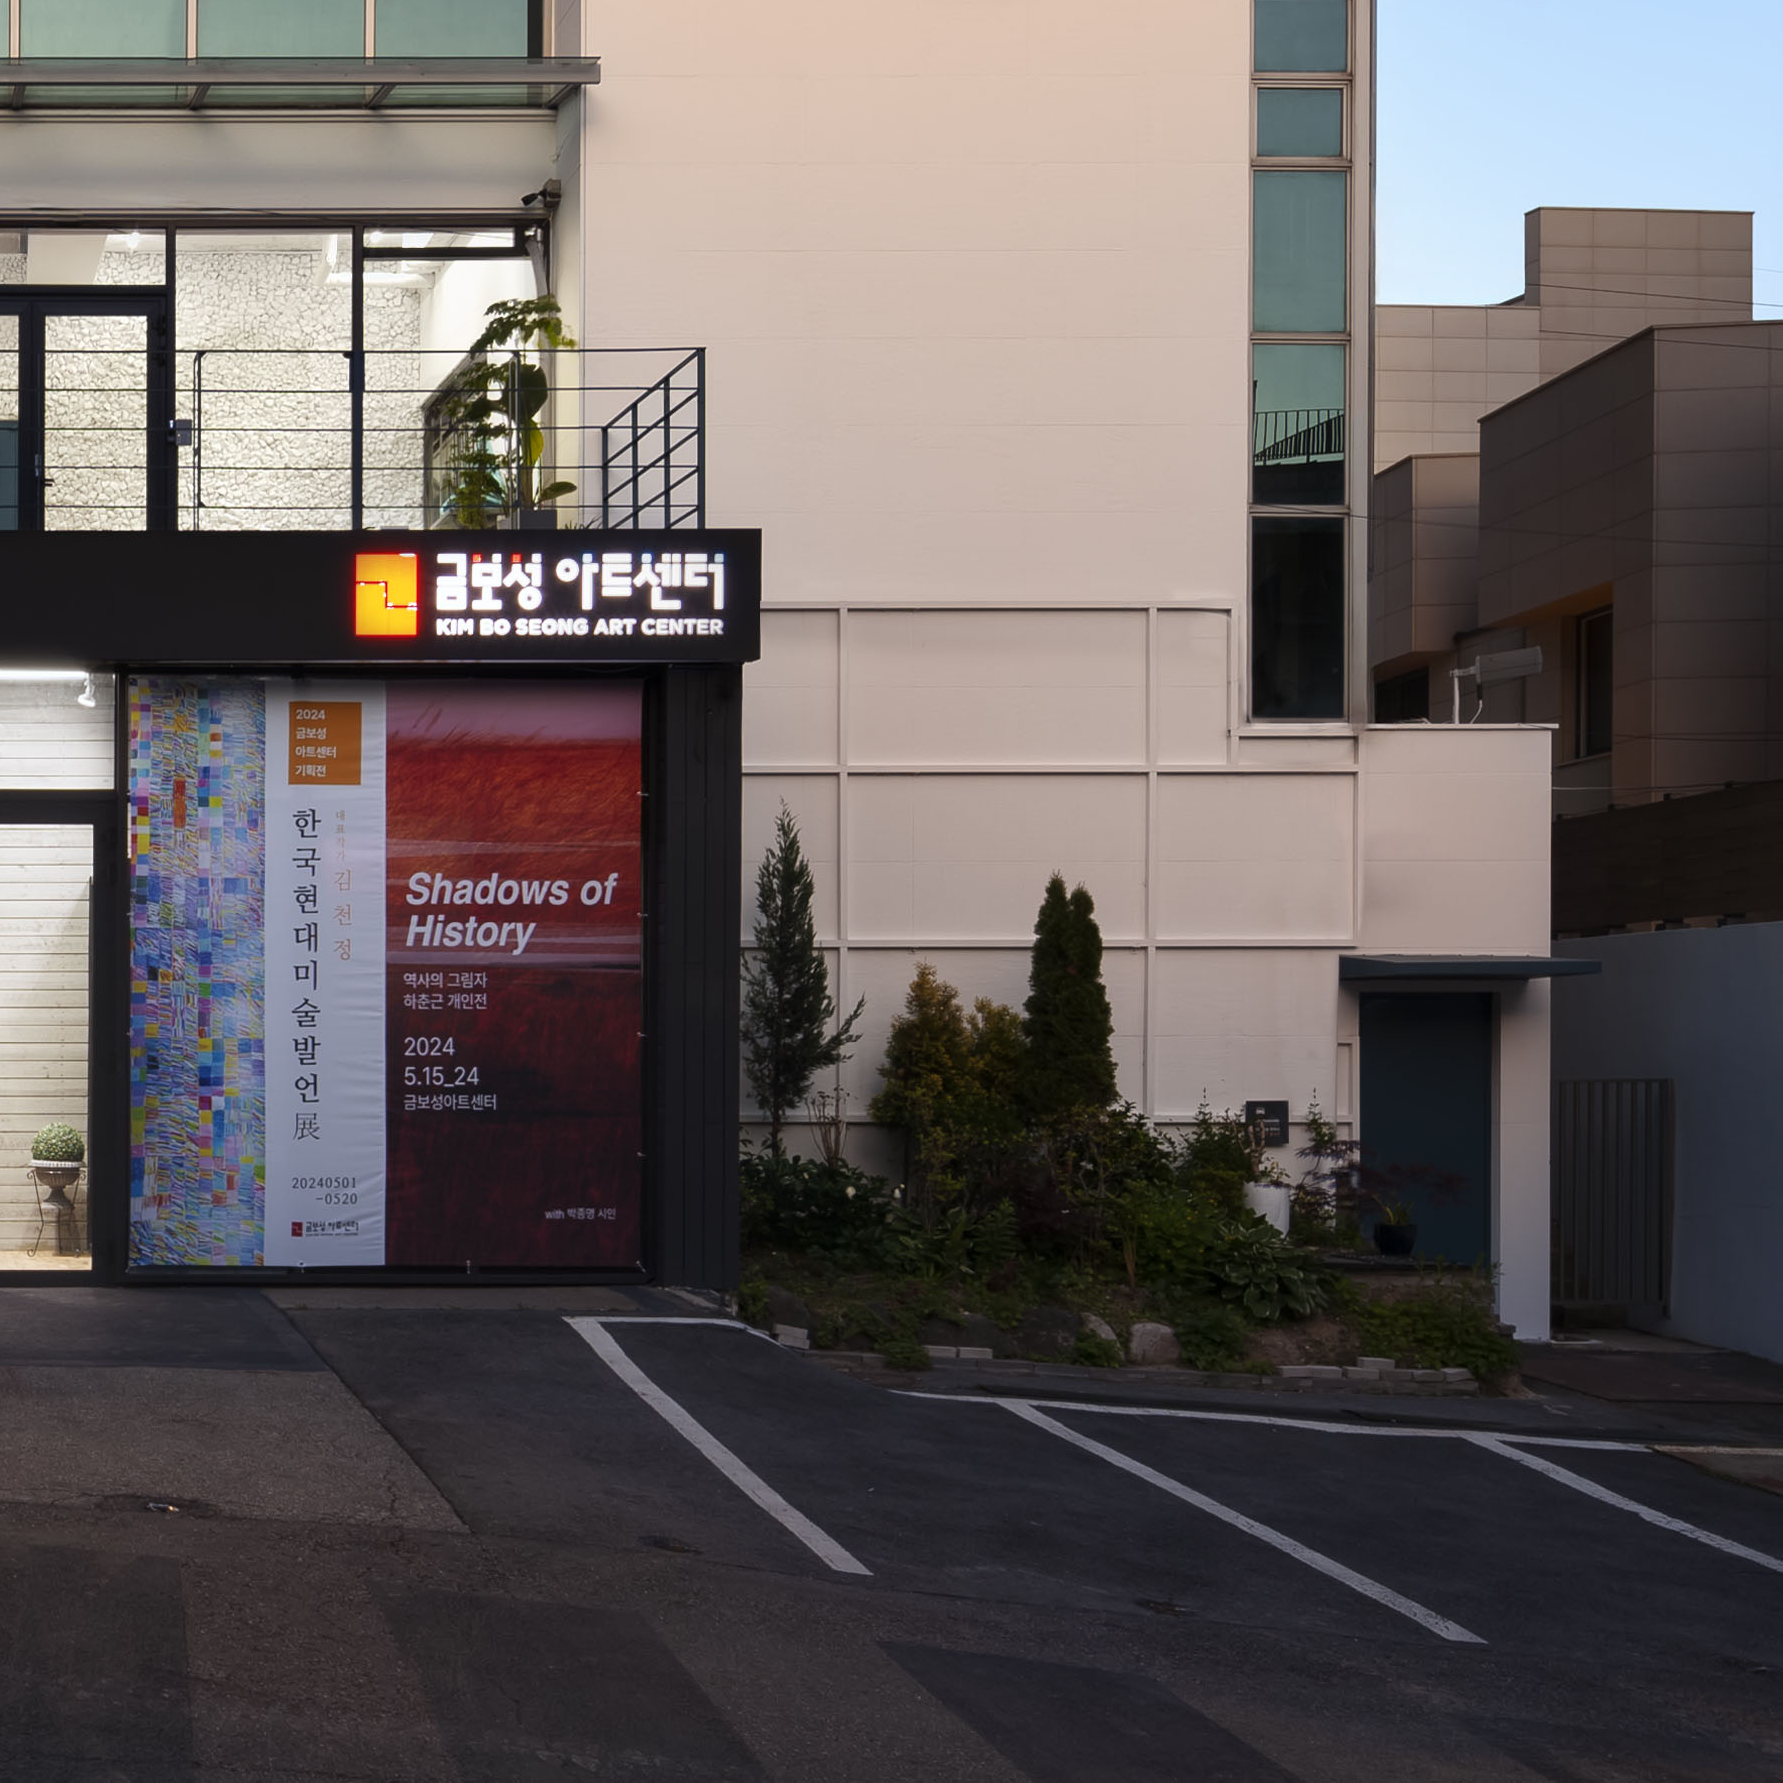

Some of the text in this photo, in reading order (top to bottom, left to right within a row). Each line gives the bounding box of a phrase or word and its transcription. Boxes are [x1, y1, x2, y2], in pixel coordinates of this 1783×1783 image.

[436, 553, 724, 610] 금보성 아트센터
[436, 618, 724, 636] KIM BO SEONG ART CENTER
[296, 709, 326, 720] 2024
[296, 727, 327, 739] 금보성
[295, 745, 337, 758] 아트센터
[406, 872, 619, 906] Shadows of
[406, 915, 537, 956] History
[403, 972, 488, 989] 역사의 그림자
[403, 993, 488, 1010] 하춘근 개인전
[404, 1036, 456, 1056] 2024
[404, 1066, 480, 1087] 5.15_24
[403, 1094, 498, 1111] 금보성아트센터
[292, 1177, 357, 1189] 20240501
